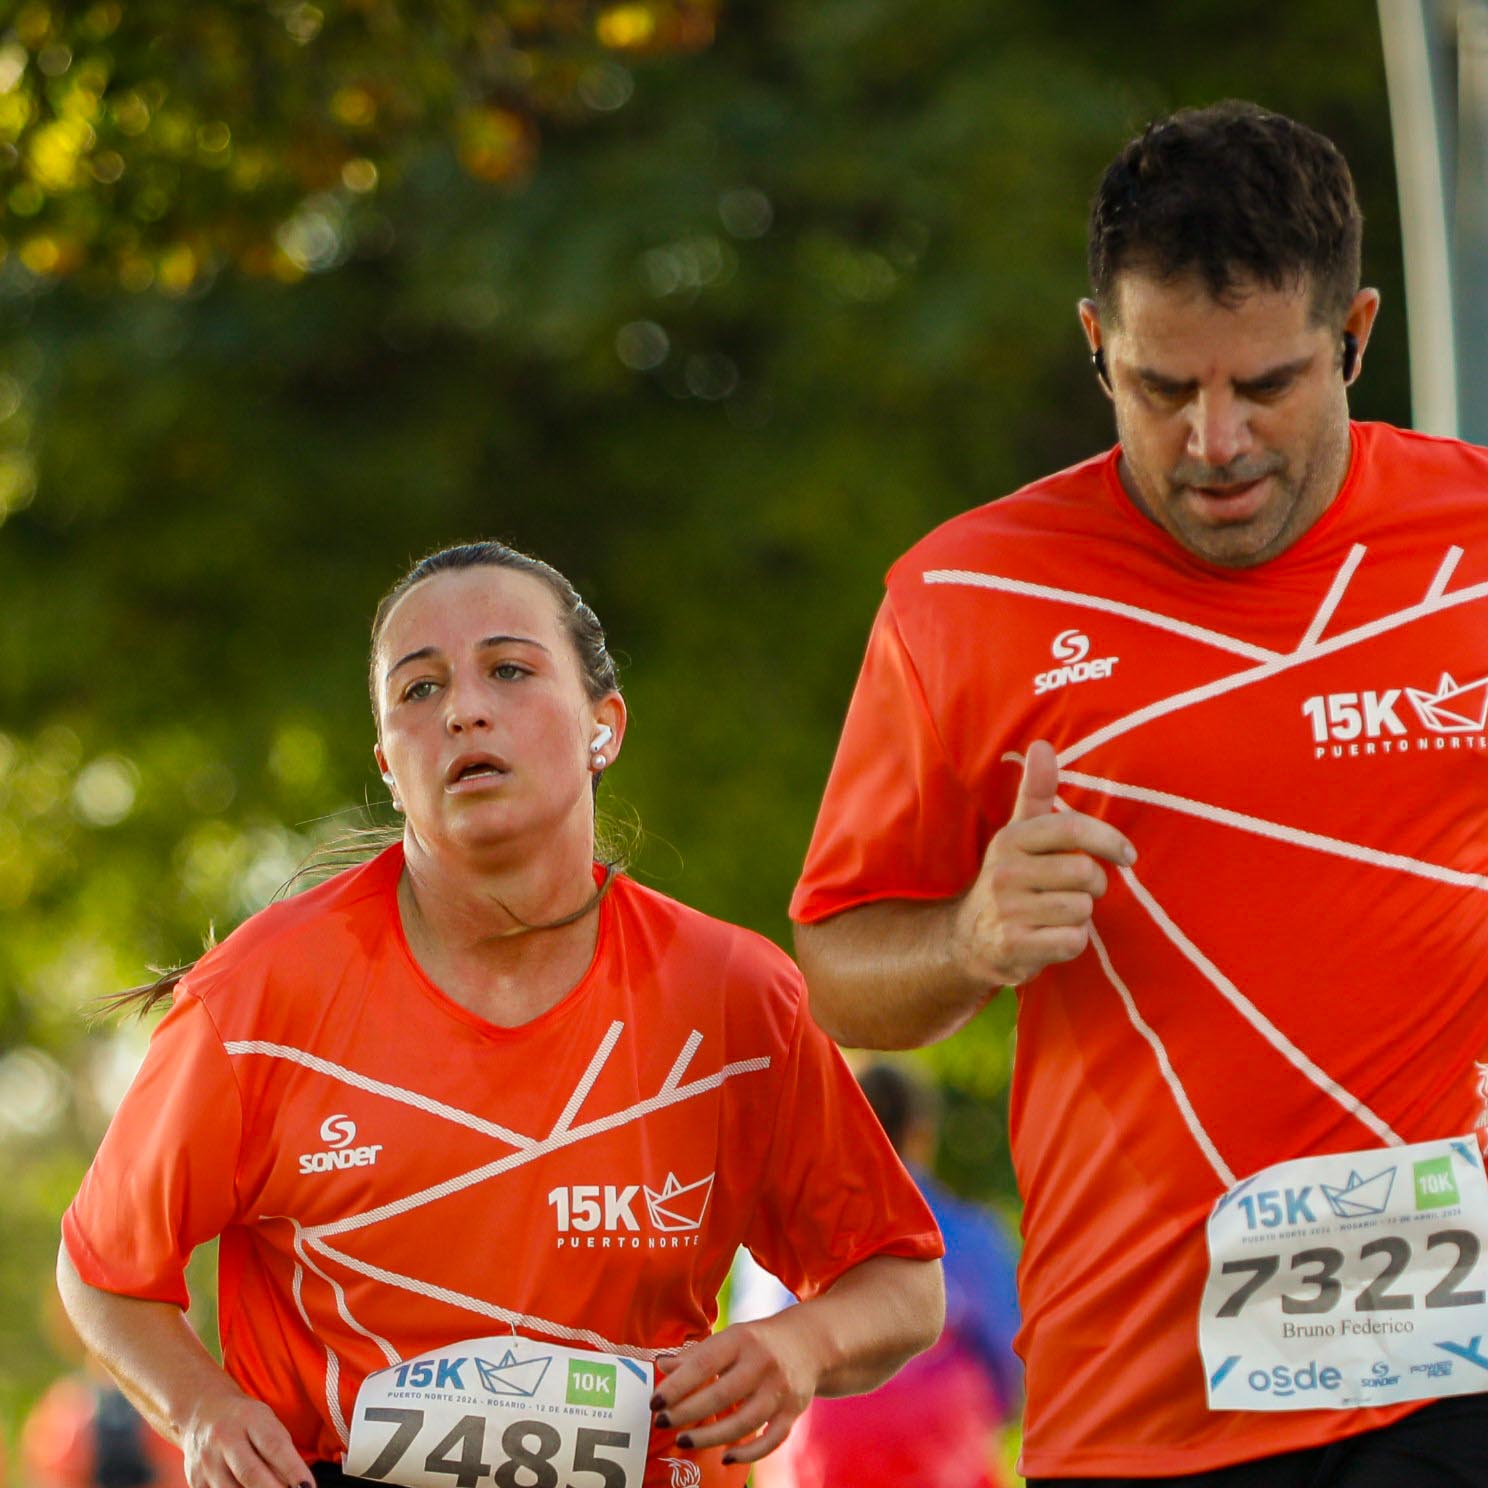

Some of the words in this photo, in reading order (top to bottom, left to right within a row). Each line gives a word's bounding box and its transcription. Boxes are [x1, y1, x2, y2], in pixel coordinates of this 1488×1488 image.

[1302, 688, 1407, 742] 15K
[1316, 740, 1409, 759] PUERTO
[1418, 736, 1487, 750] NORTE
[1419, 1171, 1454, 1195] 10K
[548, 1185, 641, 1232] 15K
[1238, 1186, 1317, 1230] 15K
[557, 1236, 640, 1249] PUERTO
[648, 1234, 699, 1249] NORTE
[1215, 1229, 1487, 1318] 7322
[1282, 1321, 1336, 1339] Bruno
[1340, 1318, 1415, 1336] Federico
[394, 1358, 468, 1390] 15K
[572, 1371, 610, 1393] 10K
[1248, 1360, 1342, 1392] osde
[387, 1391, 422, 1400] PUERTO
[424, 1392, 454, 1402] NORTE
[487, 1398, 526, 1410] ROSARIO
[536, 1404, 546, 1412] 12
[549, 1405, 561, 1414] DE
[563, 1406, 589, 1417] ABRIL
